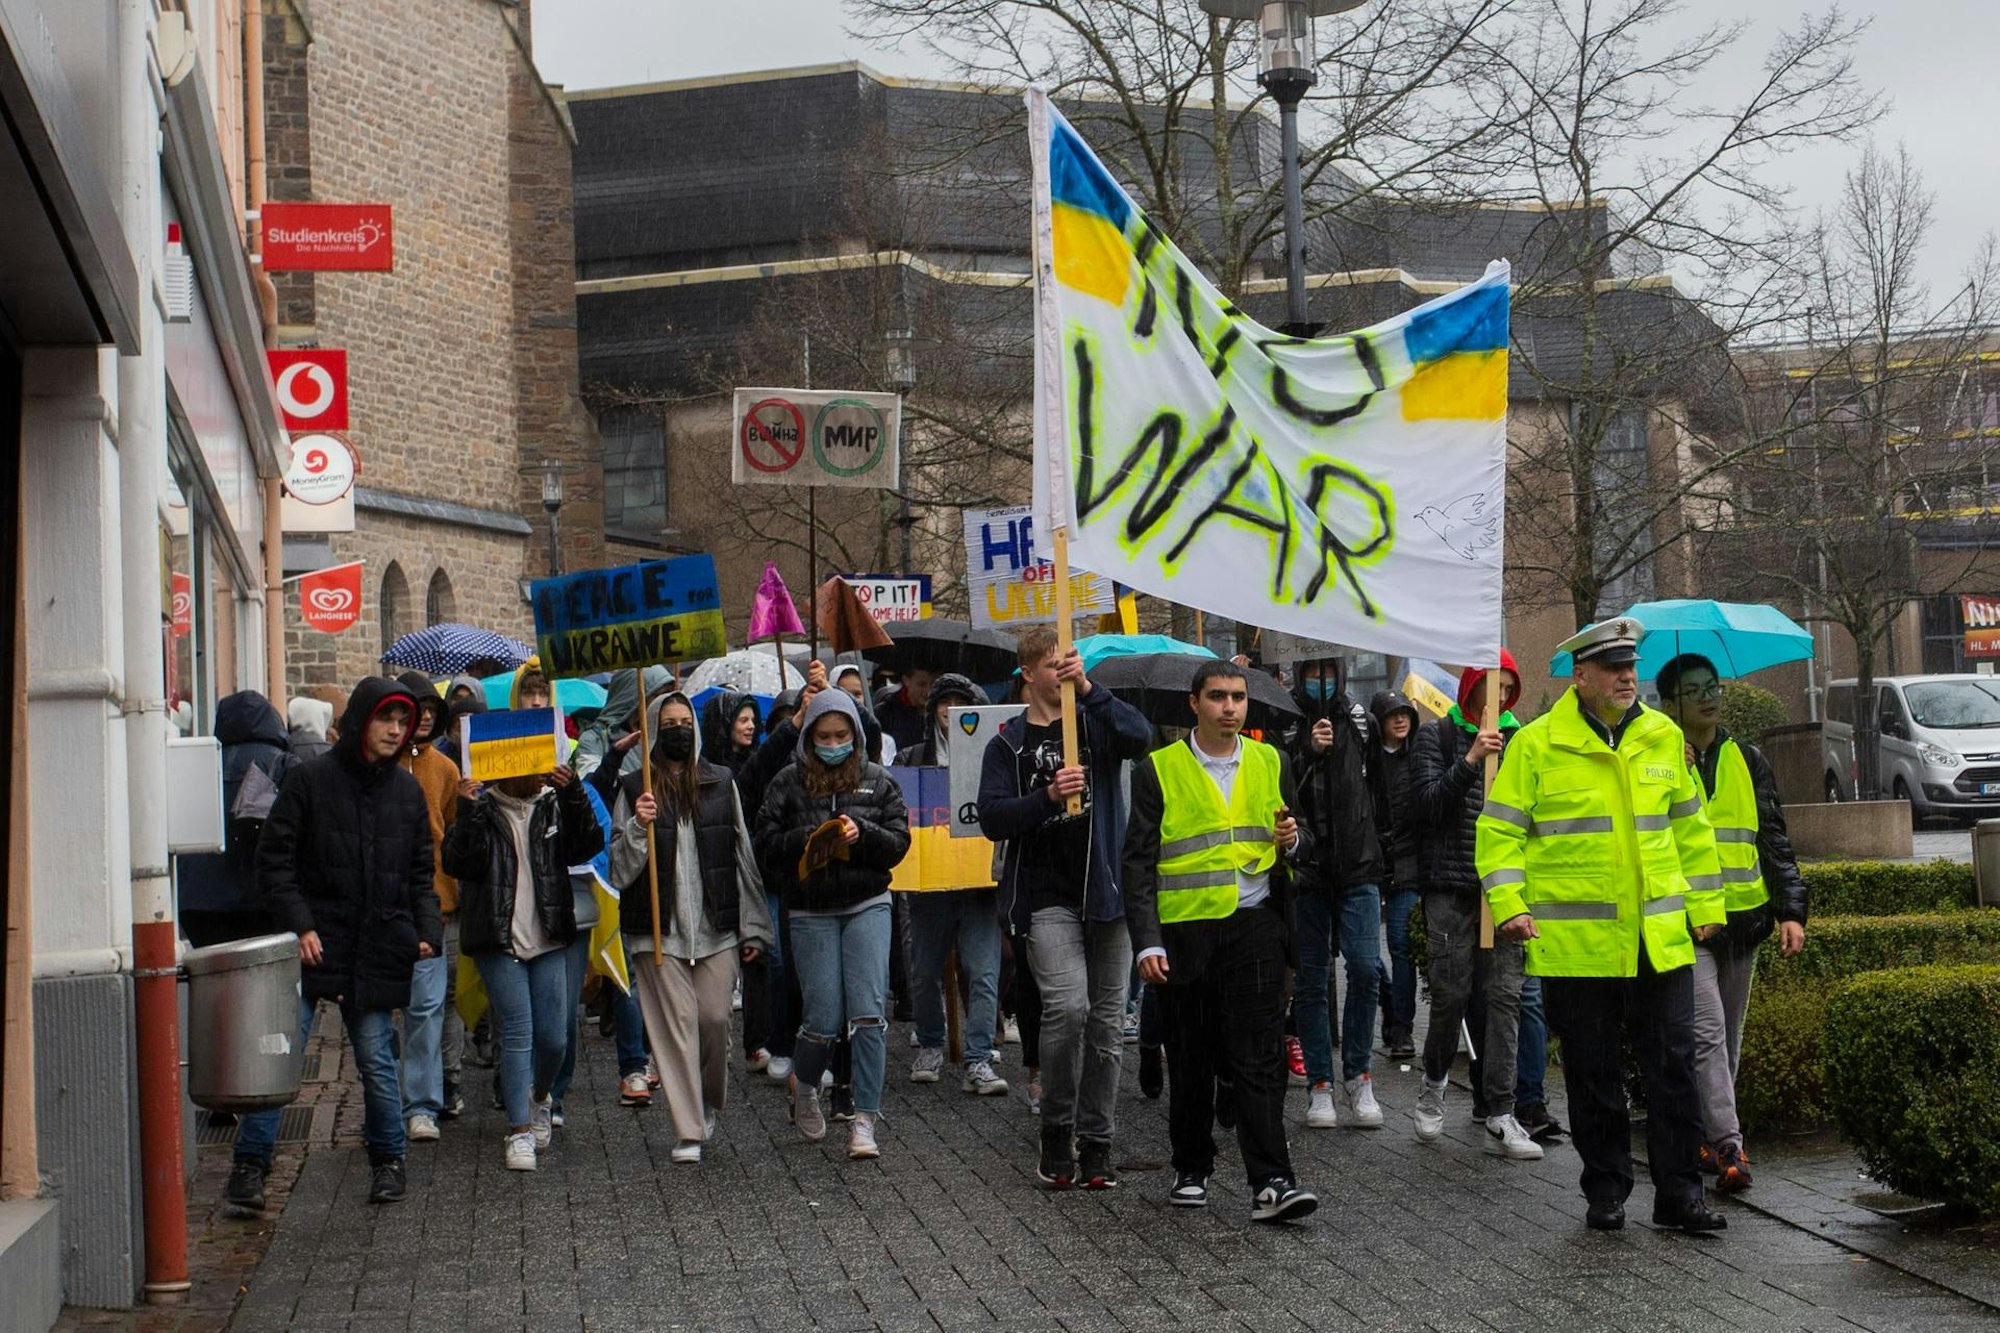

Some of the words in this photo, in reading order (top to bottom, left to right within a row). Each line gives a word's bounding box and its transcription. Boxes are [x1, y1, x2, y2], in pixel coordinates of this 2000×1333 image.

[268, 228, 366, 243] Studienkreis
[291, 474, 345, 486] MoneyGram
[1075, 337, 1391, 618] WAR
[537, 564, 674, 630] PEACE
[892, 584, 918, 606] IT!
[308, 611, 353, 621] LANGNESE
[895, 607, 919, 621] HELP
[550, 621, 683, 673] UKRAINE
[1645, 767, 1675, 781] POLIZEI
